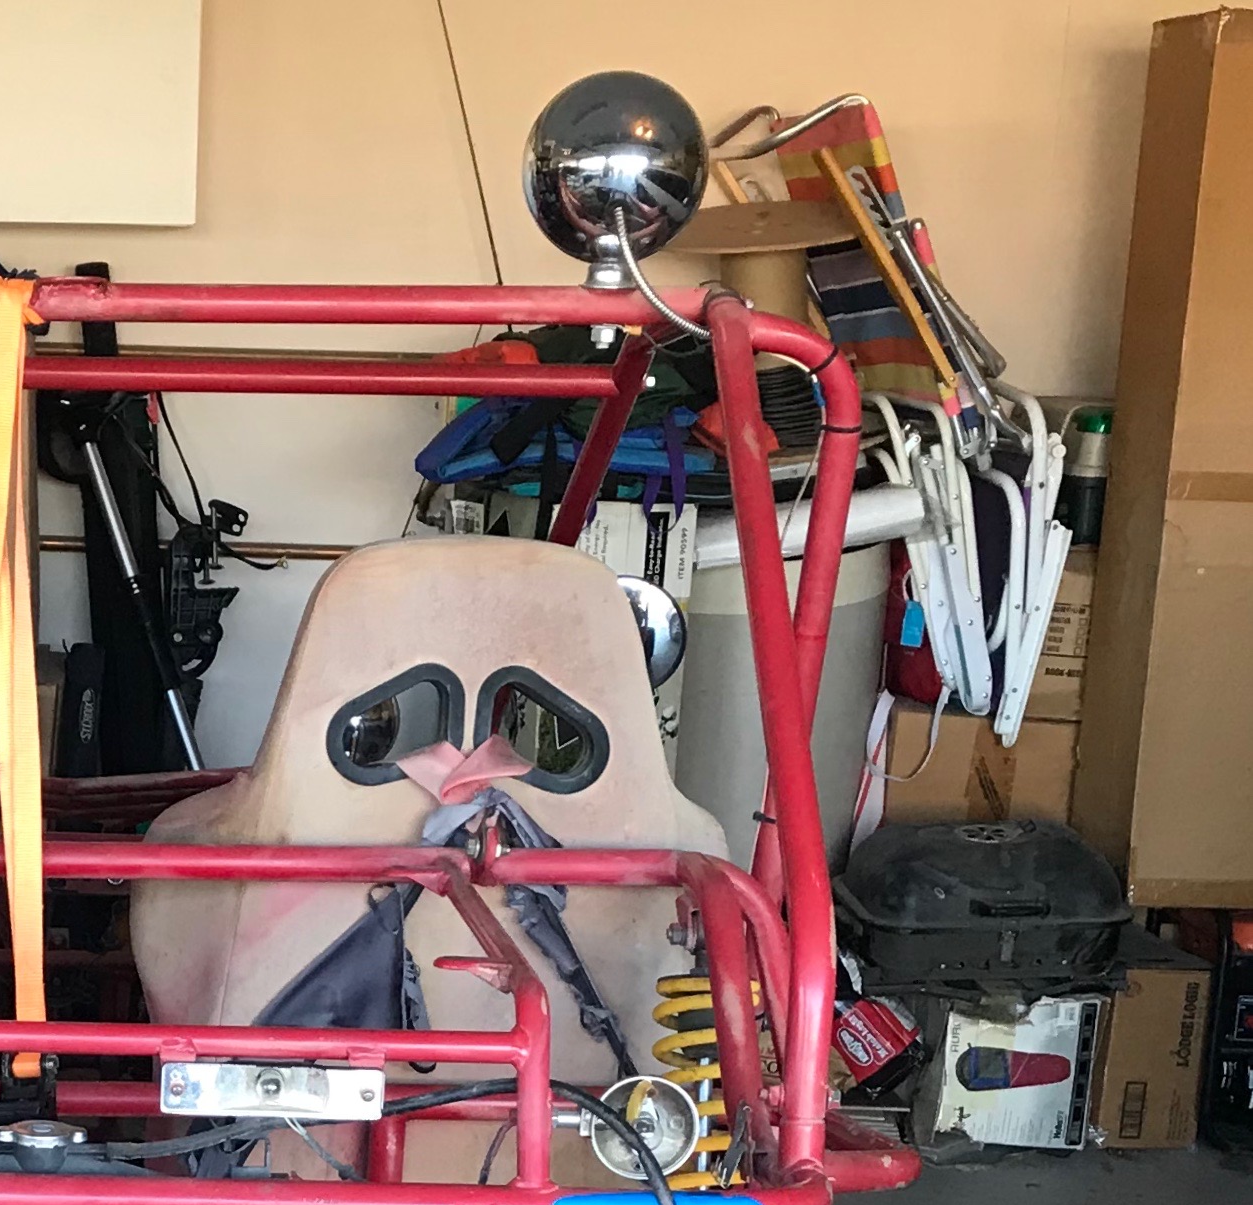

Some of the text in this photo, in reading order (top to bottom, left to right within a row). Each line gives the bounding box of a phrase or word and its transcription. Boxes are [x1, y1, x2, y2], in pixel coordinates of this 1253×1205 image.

[678, 558, 686, 580] ITEM
[1172, 1022, 1194, 1068] LODGE
[1183, 981, 1200, 1020] LOGIC
